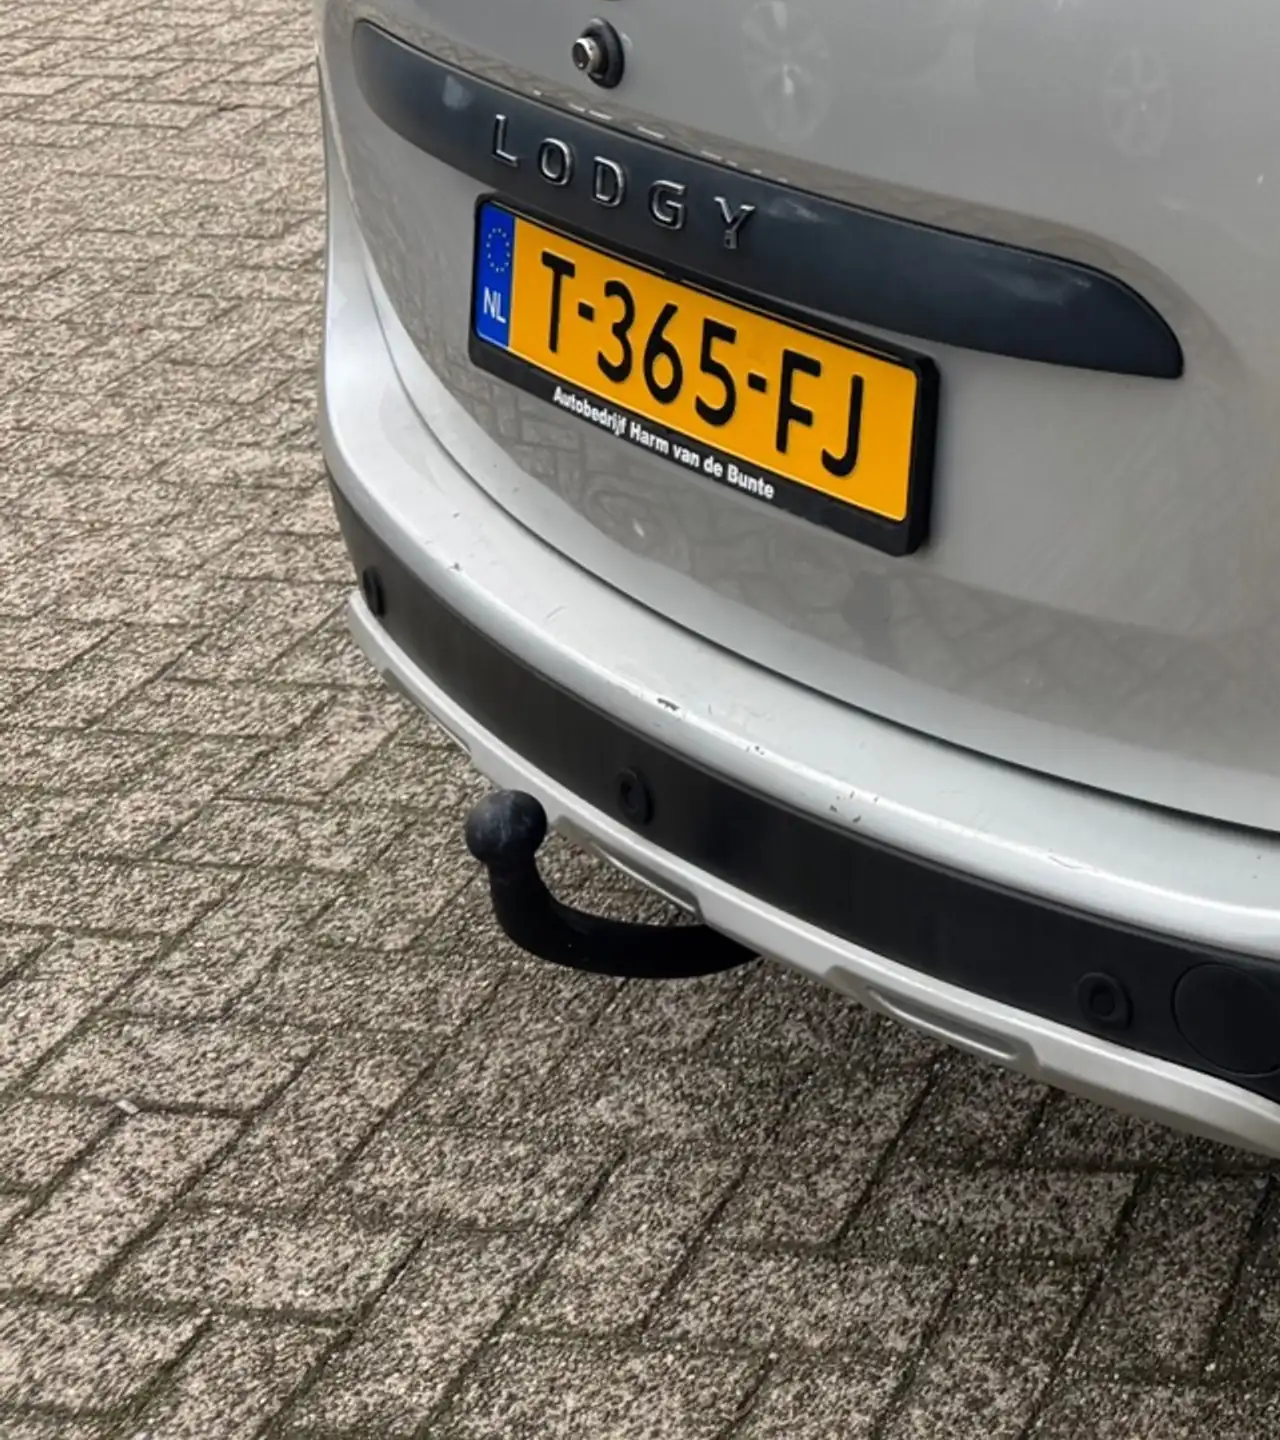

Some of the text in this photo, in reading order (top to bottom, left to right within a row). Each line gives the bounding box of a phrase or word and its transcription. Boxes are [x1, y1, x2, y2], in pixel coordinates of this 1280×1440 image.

[492, 114, 755, 250] LODGY
[483, 287, 507, 324] NL
[541, 251, 864, 478] T-365-FJ
[553, 386, 776, 500] Autobedrijf Harm van de Bunte
